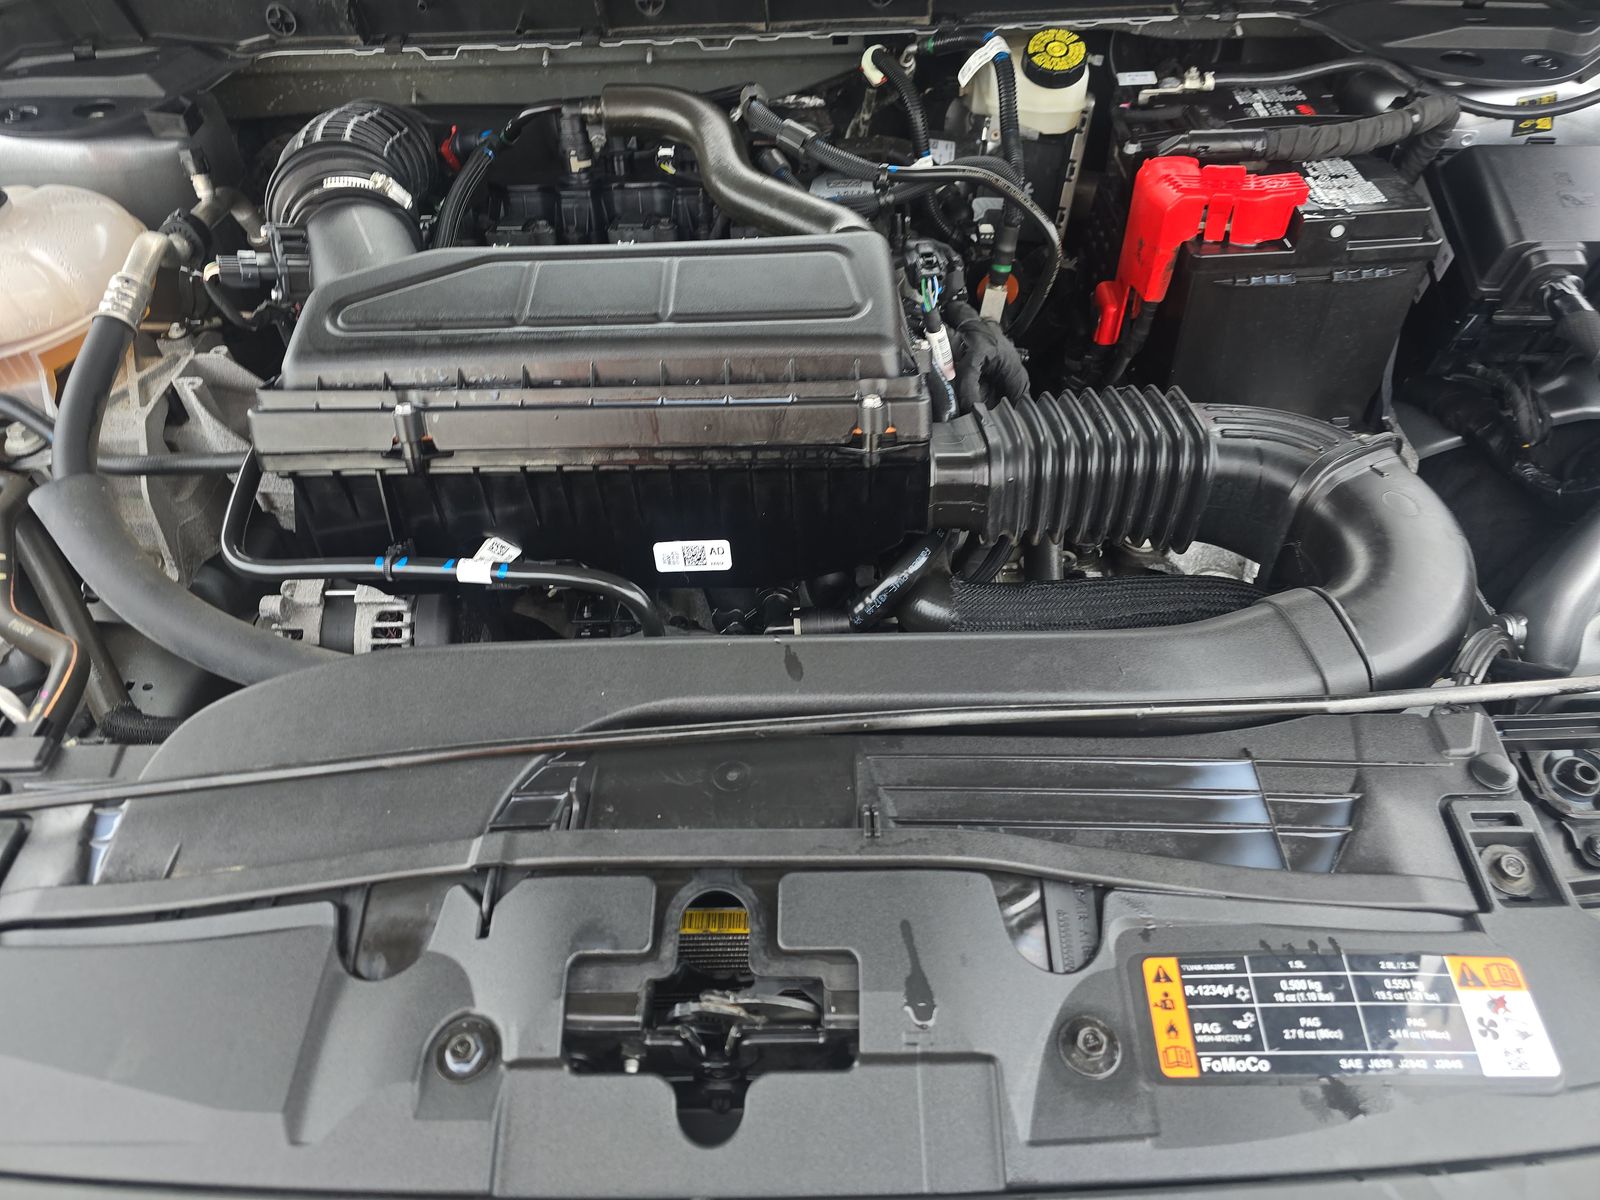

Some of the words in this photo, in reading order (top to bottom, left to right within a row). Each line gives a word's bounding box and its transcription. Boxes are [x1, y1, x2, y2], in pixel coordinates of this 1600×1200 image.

[710, 546, 725, 556] AD
[1184, 984, 1234, 998] R-1234yf
[1280, 979, 1307, 991] 0.500
[1307, 979, 1323, 992] kg
[1384, 979, 1410, 990] 0.550
[1410, 979, 1424, 991] kg
[1285, 994, 1296, 1002] oz
[1194, 1022, 1222, 1034] PAG
[1299, 1017, 1322, 1028] PAG
[1200, 1056, 1271, 1073] FoMoCo
[1338, 1058, 1363, 1069] SAE
